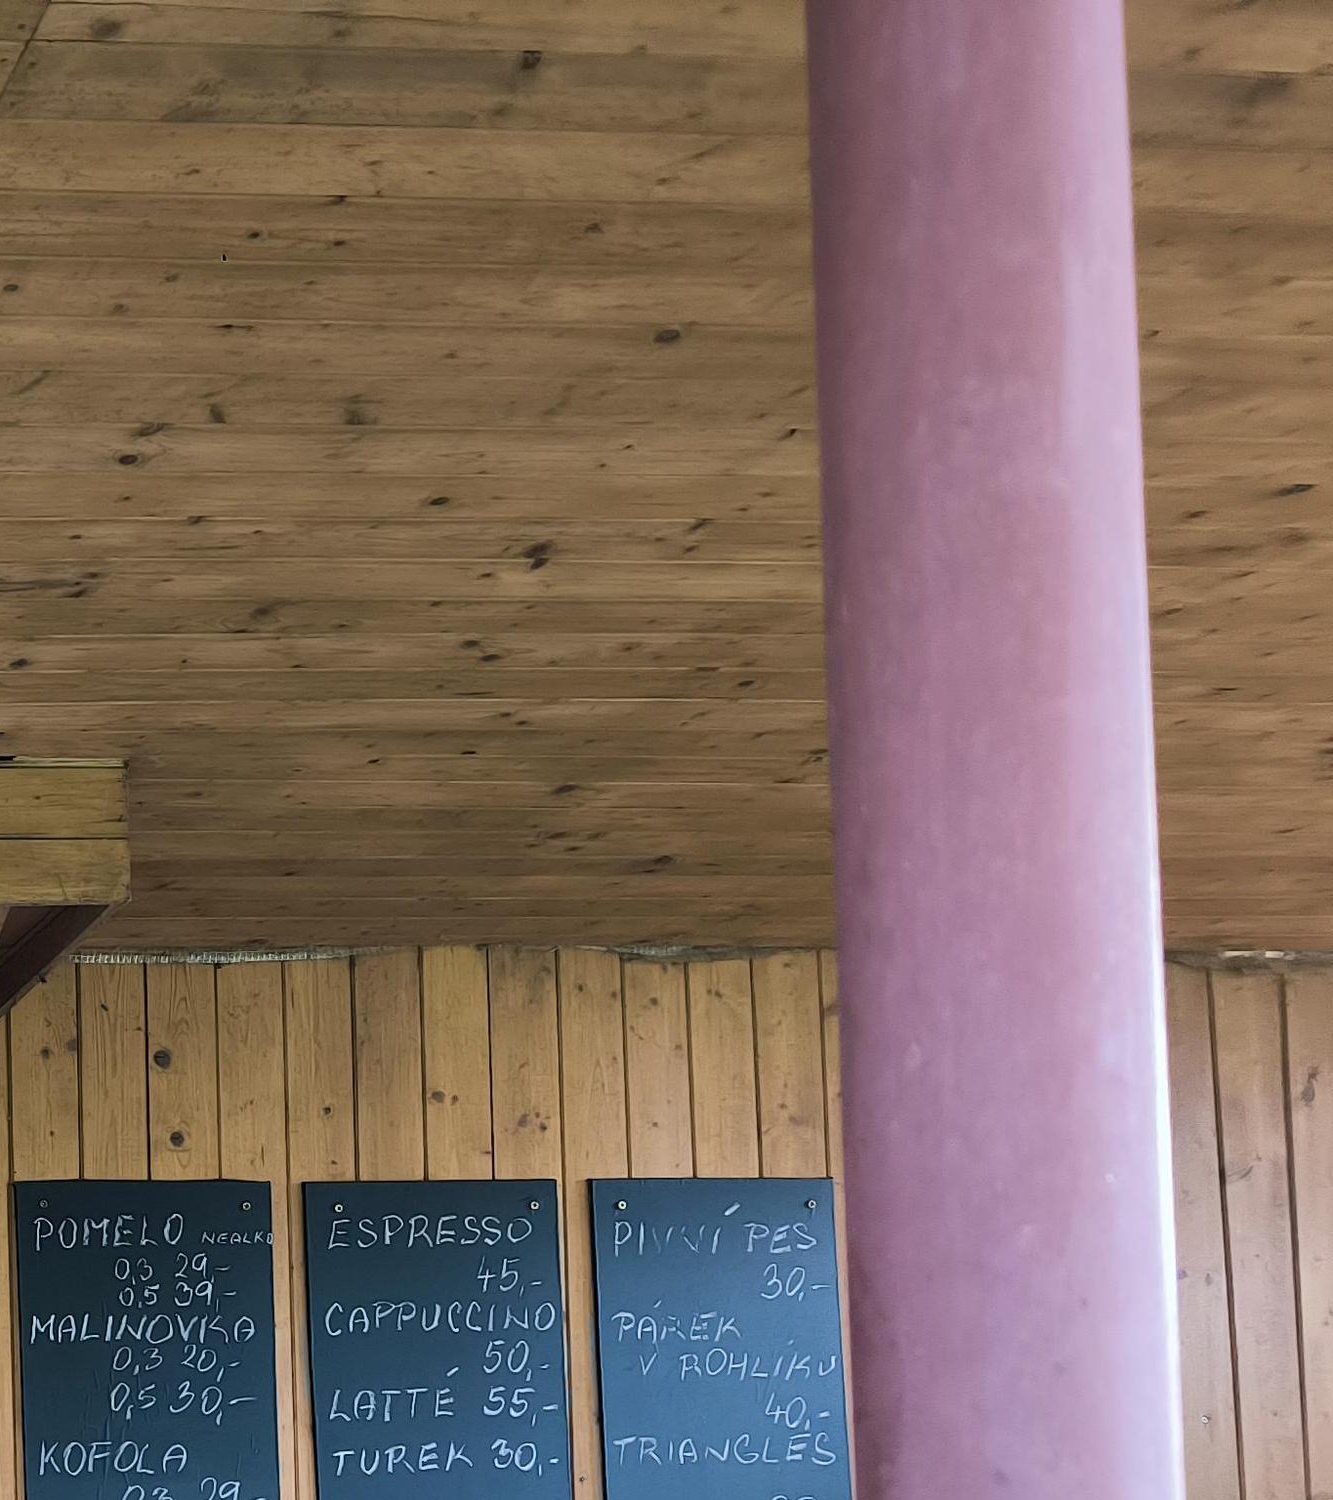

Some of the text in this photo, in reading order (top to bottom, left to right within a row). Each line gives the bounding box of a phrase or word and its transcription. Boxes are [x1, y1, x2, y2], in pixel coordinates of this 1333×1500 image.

[33, 1213, 185, 1252] POMELO
[327, 1214, 534, 1250] ESPRESSO
[743, 1221, 819, 1255] PES
[114, 1257, 154, 1285] 0,3
[118, 1284, 161, 1309] 0,5
[30, 1313, 257, 1345] MALINOVKA
[324, 1301, 557, 1337] CAPPUCCINO
[112, 1346, 164, 1376] 0,3
[679, 1339, 837, 1382] ROHLÍKU
[110, 1381, 158, 1421] 0,5
[328, 1366, 461, 1423] LATTÉ
[39, 1440, 190, 1477] KOFOLA
[332, 1440, 475, 1478] TUREK
[612, 1432, 838, 1467] TRIANGLES
